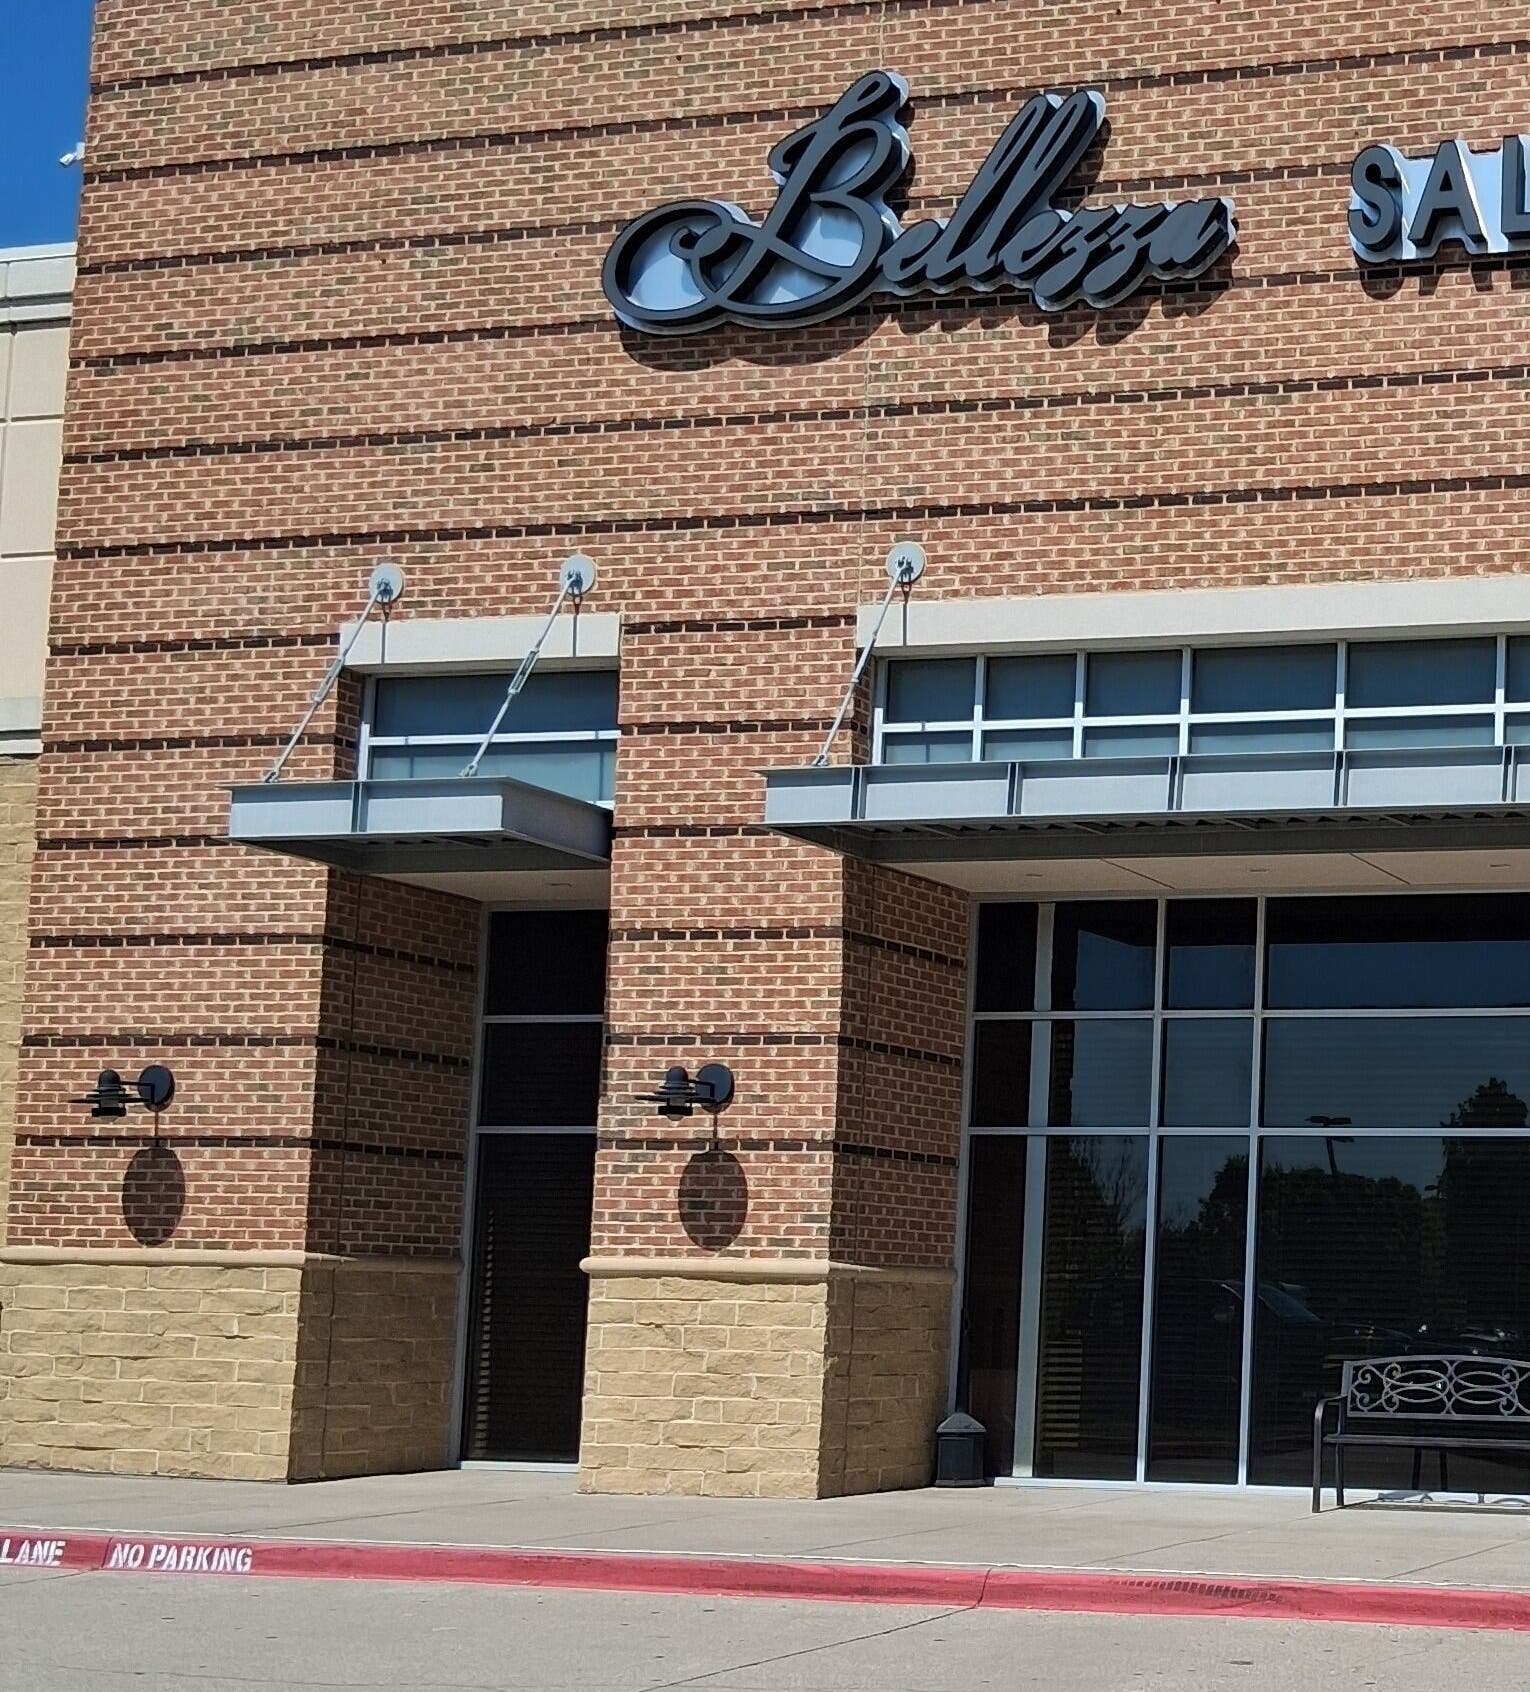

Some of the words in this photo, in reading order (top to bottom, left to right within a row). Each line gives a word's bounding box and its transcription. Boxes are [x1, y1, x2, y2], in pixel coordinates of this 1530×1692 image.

[601, 70, 1236, 336] Bellezza
[0, 1539, 66, 1566] LANE
[105, 1543, 145, 1570] NO
[150, 1544, 253, 1572] PARKING
